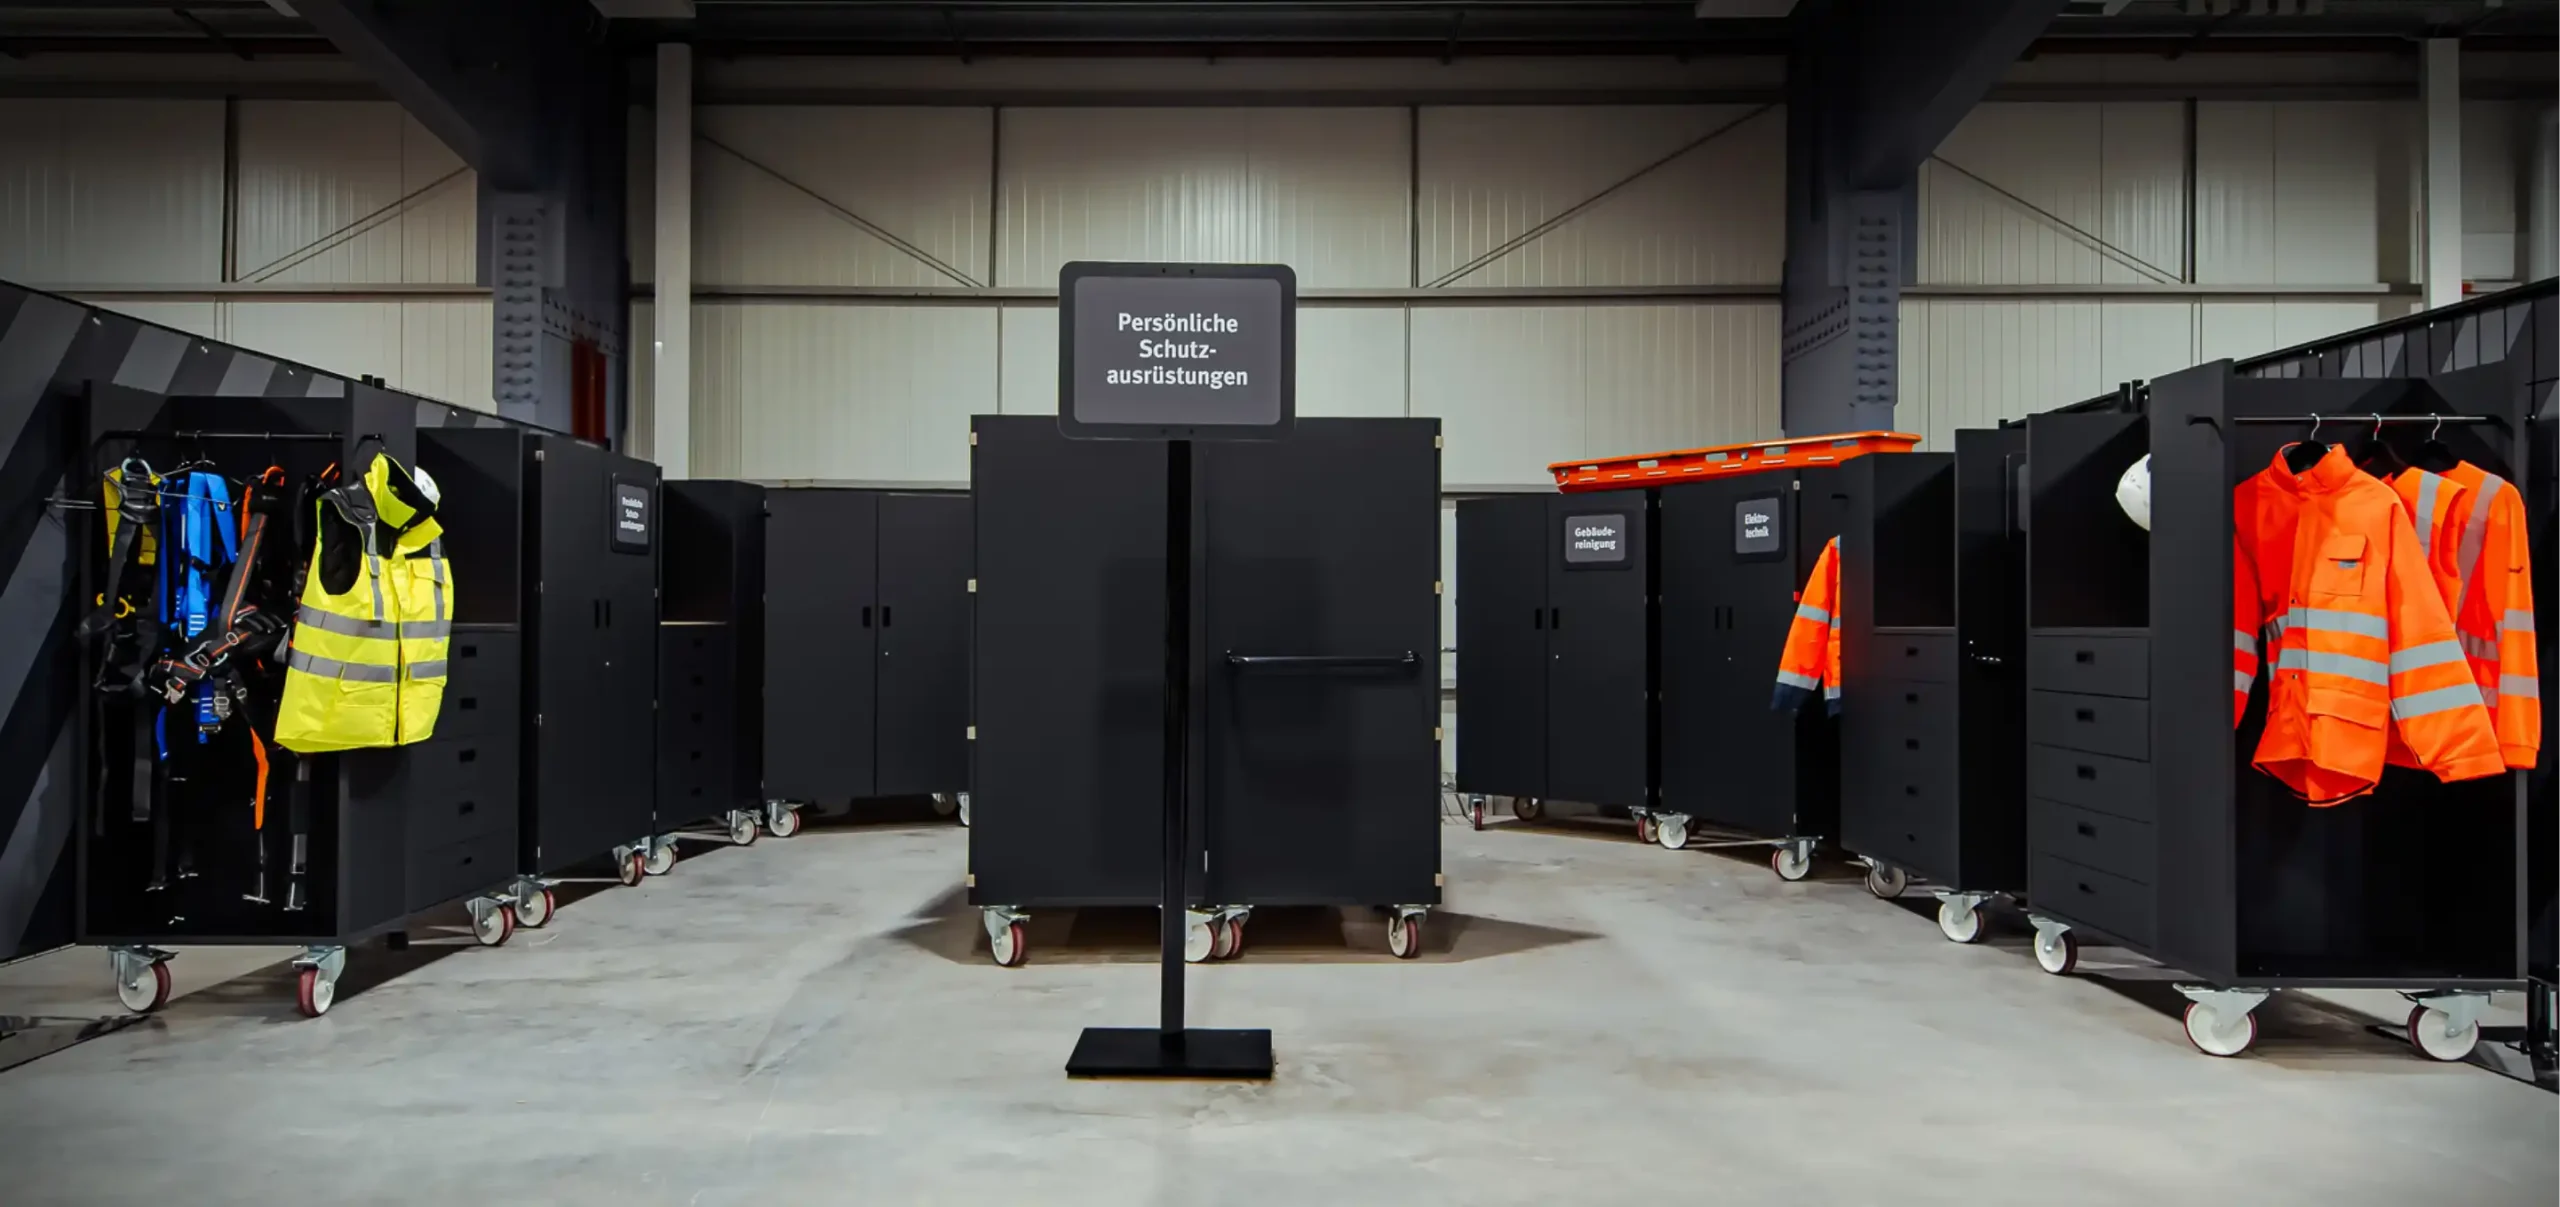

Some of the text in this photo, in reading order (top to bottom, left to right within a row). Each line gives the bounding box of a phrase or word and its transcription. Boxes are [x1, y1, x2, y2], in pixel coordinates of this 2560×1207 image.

[1118, 312, 1239, 333] Persönliche
[1139, 339, 1217, 359] Schutz-
[1106, 366, 1248, 389] ausrüstungen
[1574, 526, 1616, 538] Gebäude-
[1574, 539, 1616, 551] reinigung
